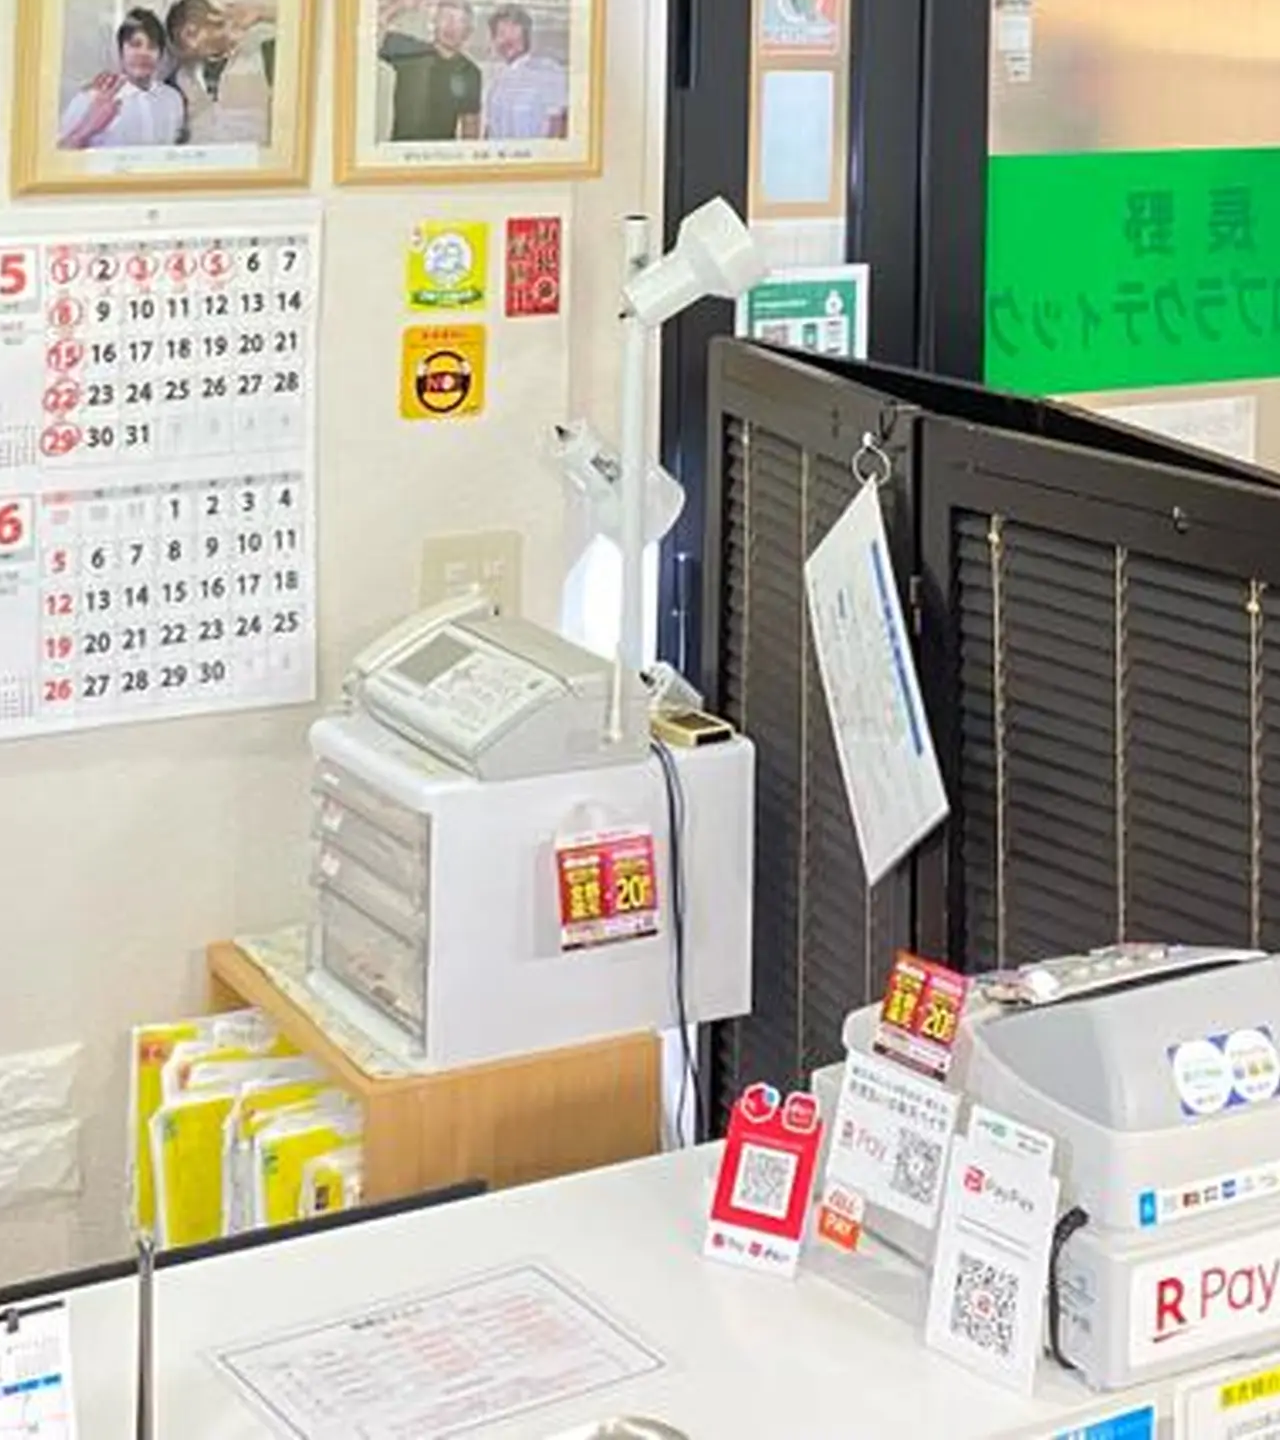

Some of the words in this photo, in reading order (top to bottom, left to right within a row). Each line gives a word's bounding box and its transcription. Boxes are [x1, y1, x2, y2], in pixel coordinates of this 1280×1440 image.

[96, 257, 110, 279] 2
[247, 252, 260, 273] 6
[284, 251, 297, 271] 7
[96, 300, 111, 323] 9
[129, 299, 155, 320] 10
[167, 297, 189, 318] 11
[205, 294, 228, 315] 12
[241, 293, 265, 313] 13
[277, 290, 302, 311] 14
[91, 343, 117, 363] 16
[129, 340, 153, 362] 17
[167, 338, 191, 359] 18
[204, 335, 228, 356] 19
[238, 333, 264, 355] 20
[275, 331, 297, 353] 21
[88, 384, 114, 406] 23
[126, 382, 152, 404] 24
[165, 379, 190, 401] 25
[202, 376, 227, 398] 26
[238, 374, 263, 395] 27
[273, 371, 299, 393] 28
[87, 426, 114, 448] 30
[126, 424, 149, 446] 31
[170, 499, 180, 519] 1
[206, 496, 219, 516] 2
[242, 491, 255, 512] 3
[279, 488, 291, 507] 4
[52, 551, 66, 574] 5
[91, 547, 105, 569] 6
[130, 543, 144, 566] 7
[168, 540, 181, 561] 8
[205, 536, 219, 558] 9
[238, 532, 262, 554] 10
[274, 529, 296, 550] 11
[47, 593, 73, 616] 12
[86, 589, 111, 611] 13
[125, 585, 149, 607] 14
[162, 580, 187, 603] 15
[201, 577, 225, 598] 16
[237, 573, 261, 595] 17
[274, 570, 298, 591] 18
[46, 636, 72, 659] 19
[84, 631, 111, 655] 20
[122, 627, 146, 650] 21
[161, 623, 187, 646] 22
[199, 618, 224, 641] 23
[235, 615, 262, 637] 24
[273, 611, 298, 633] 25
[44, 679, 72, 702] 26
[83, 674, 111, 697] 27
[123, 670, 149, 692] 28
[161, 665, 187, 688] 29
[199, 660, 226, 684] 30
